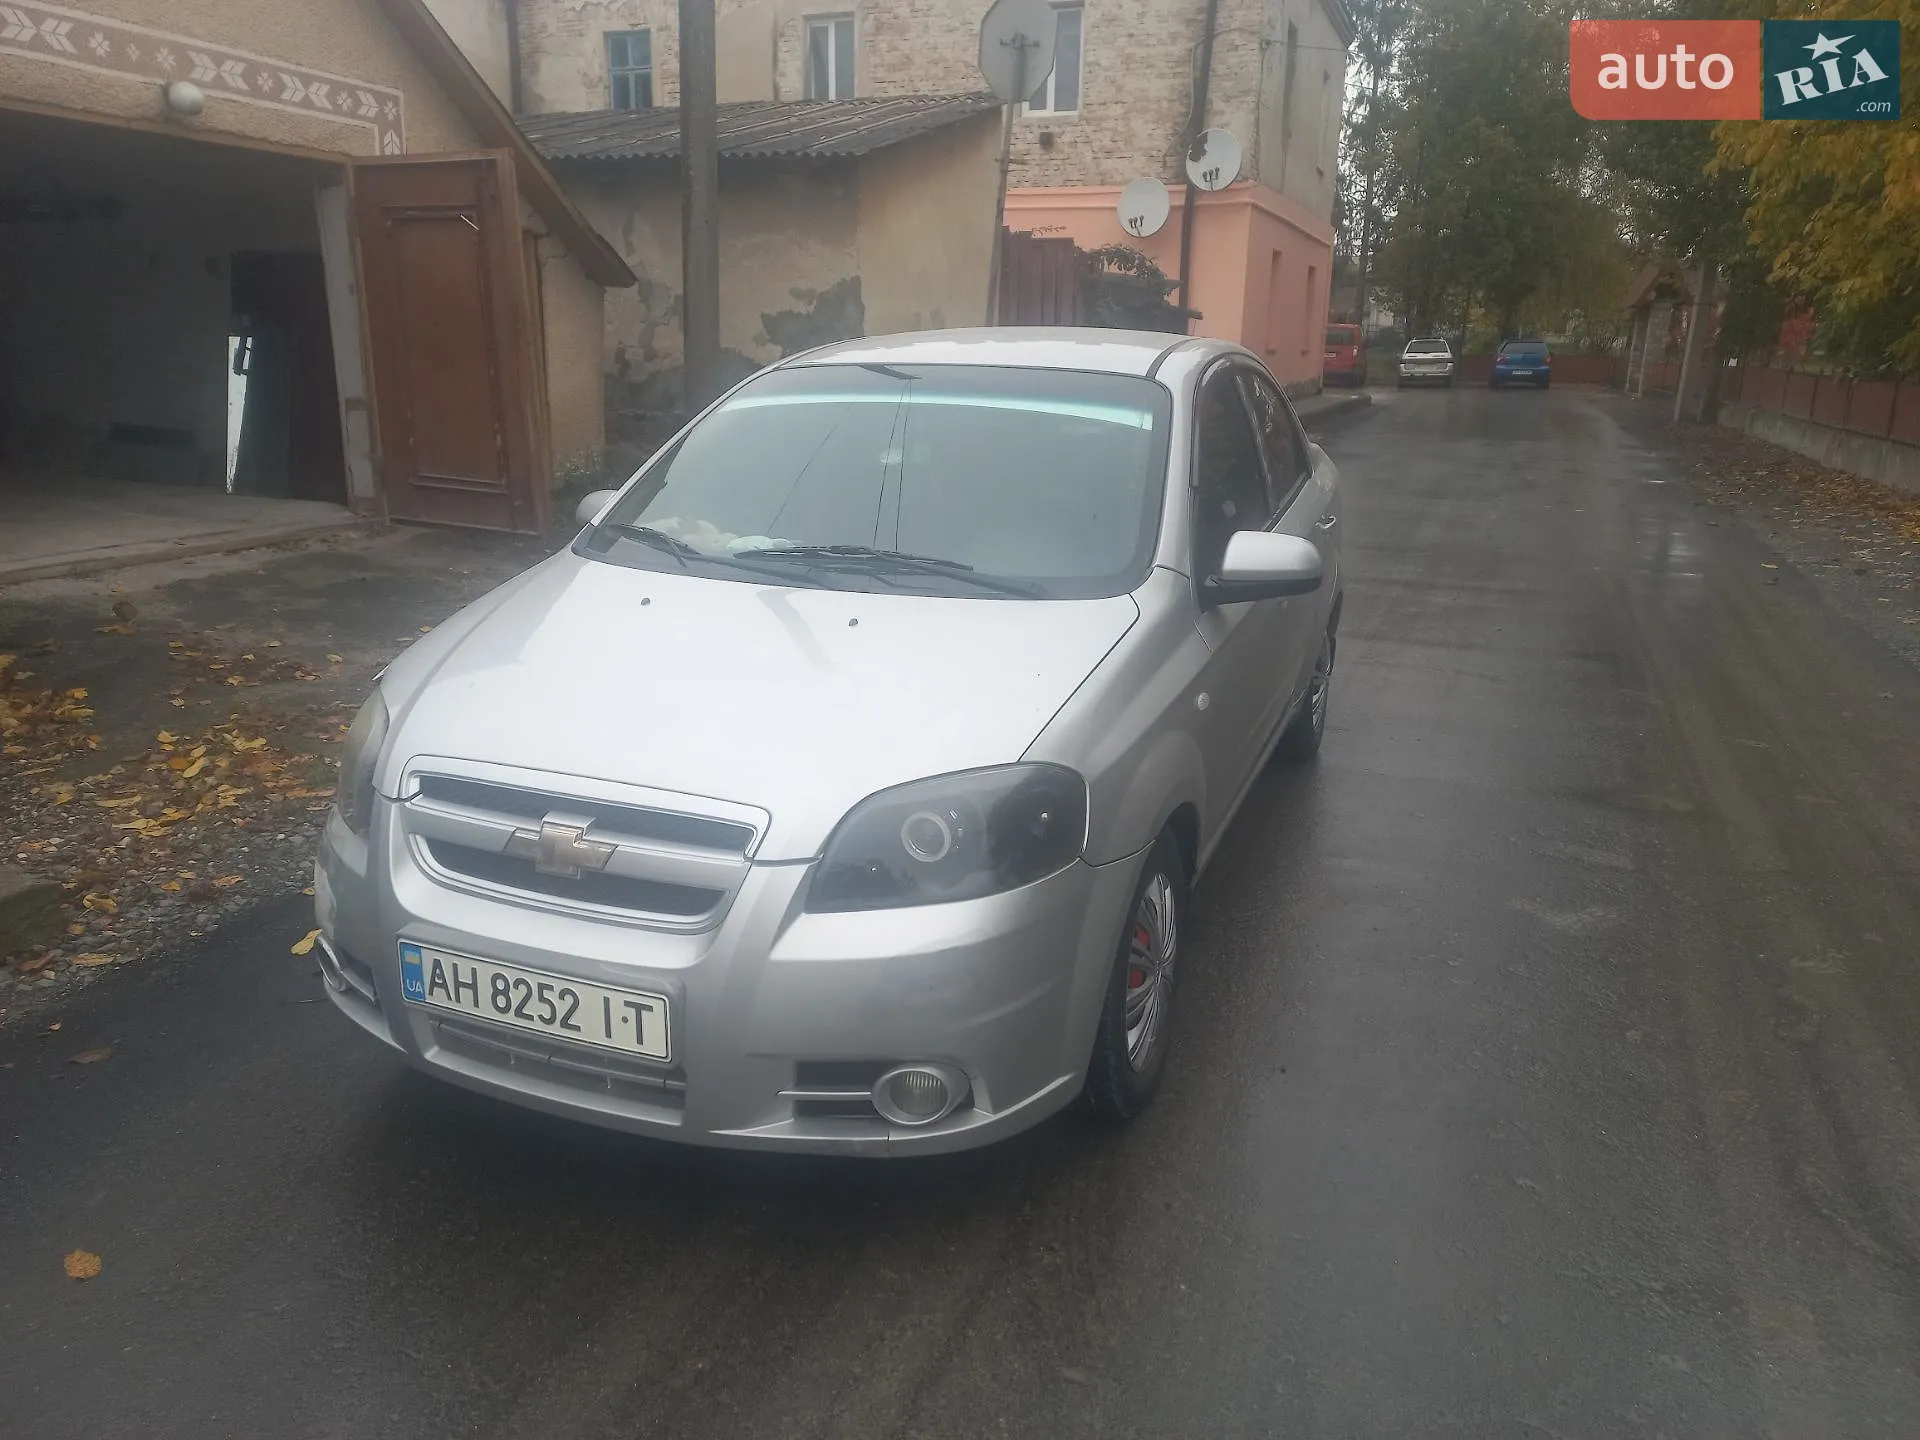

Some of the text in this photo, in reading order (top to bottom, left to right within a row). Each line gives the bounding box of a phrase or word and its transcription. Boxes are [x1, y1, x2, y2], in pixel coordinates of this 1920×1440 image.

[406, 979, 425, 994] UA
[427, 958, 654, 1045] AH 8252 IT
